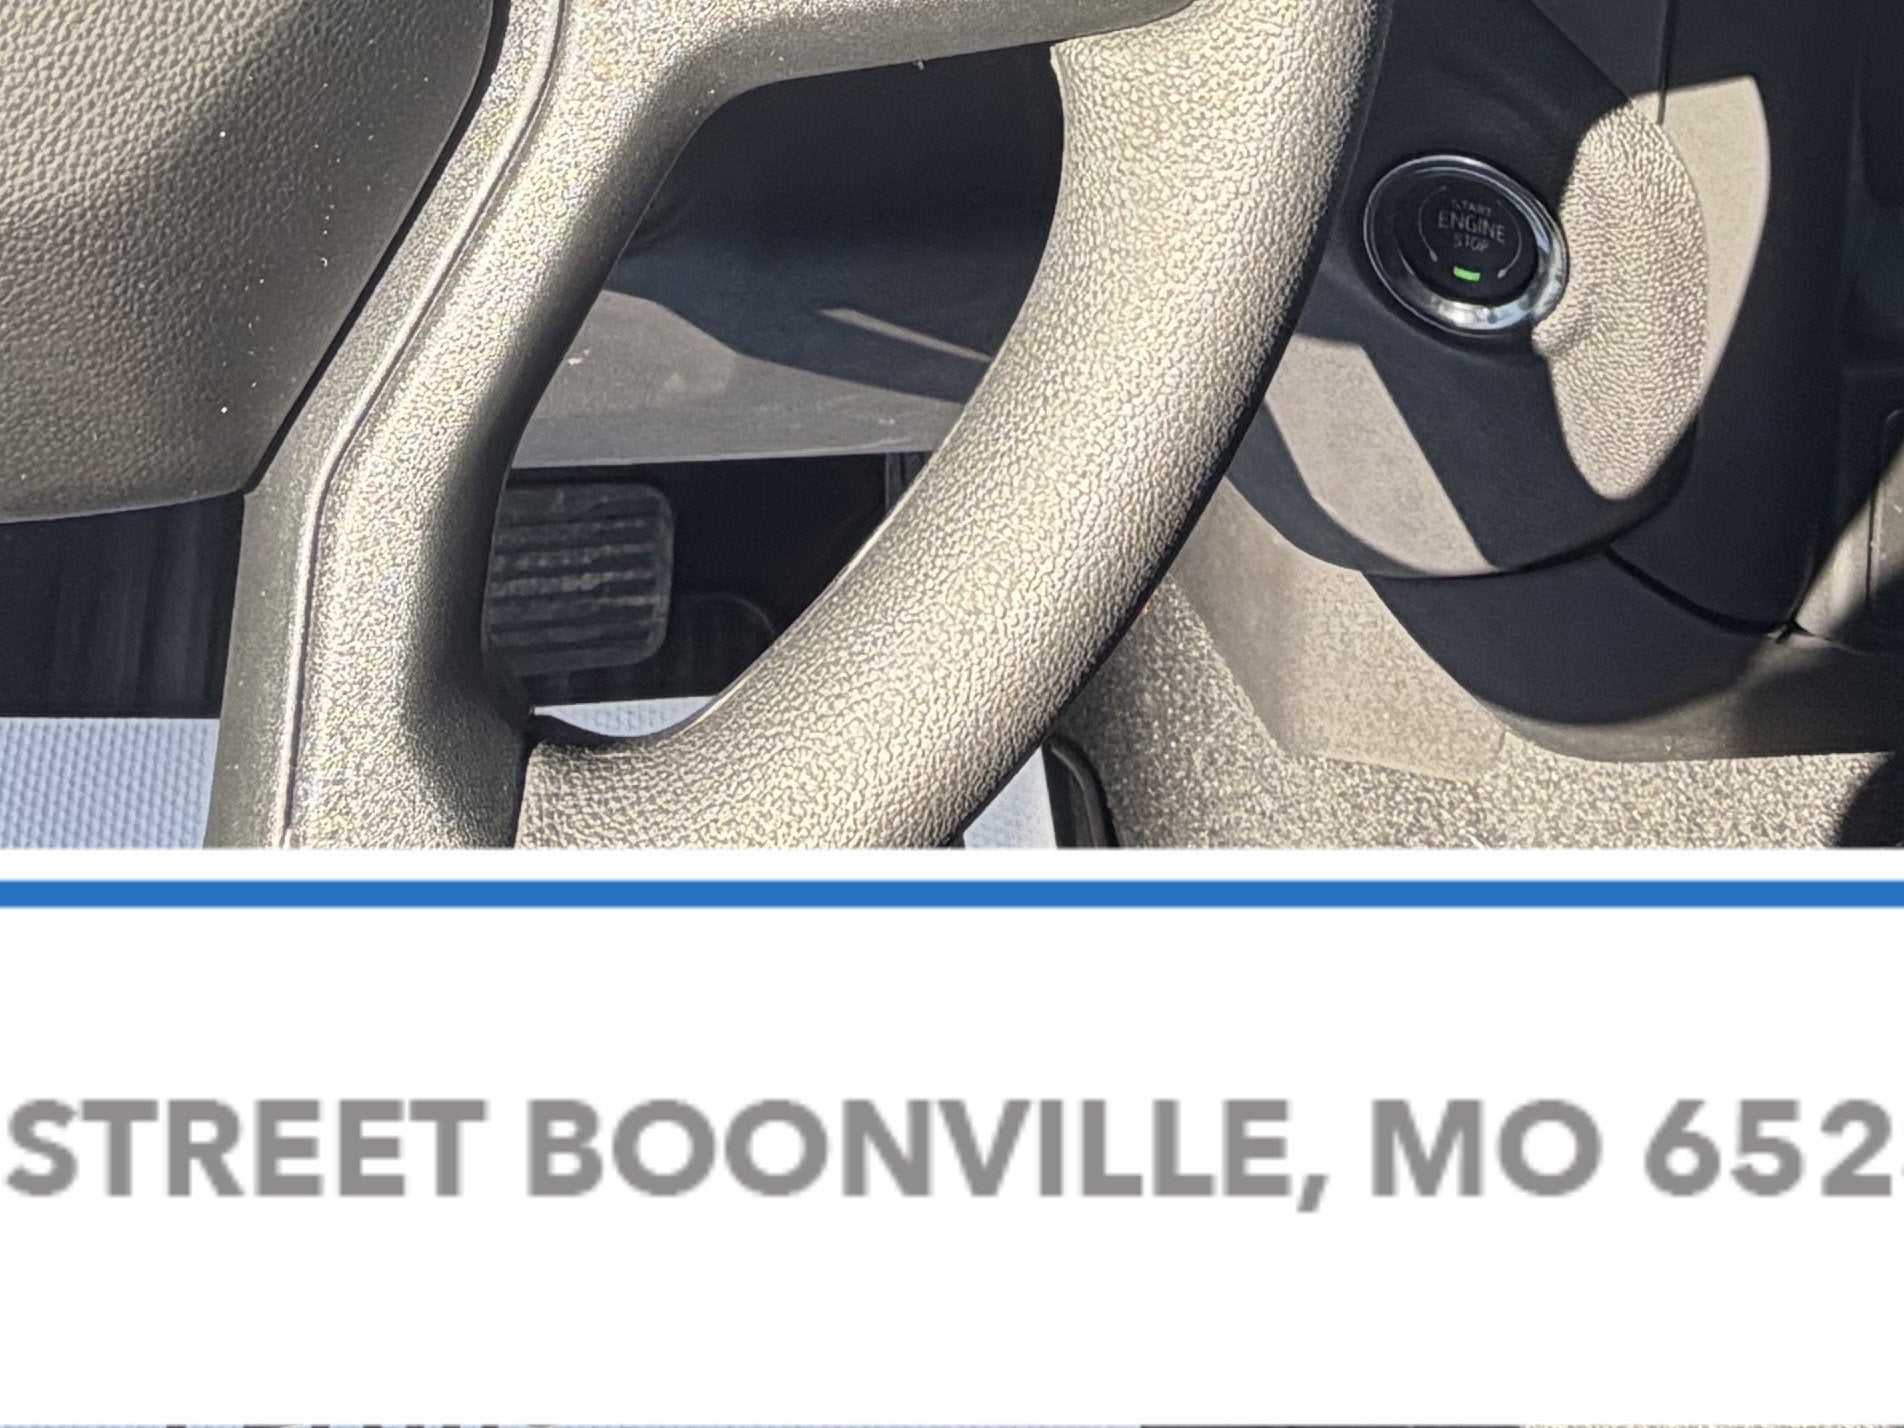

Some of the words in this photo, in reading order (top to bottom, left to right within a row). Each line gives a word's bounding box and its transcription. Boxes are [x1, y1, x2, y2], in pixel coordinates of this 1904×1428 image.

[1450, 198, 1493, 216] START
[1437, 210, 1506, 244] ENGINE
[1453, 234, 1490, 253] STOP
